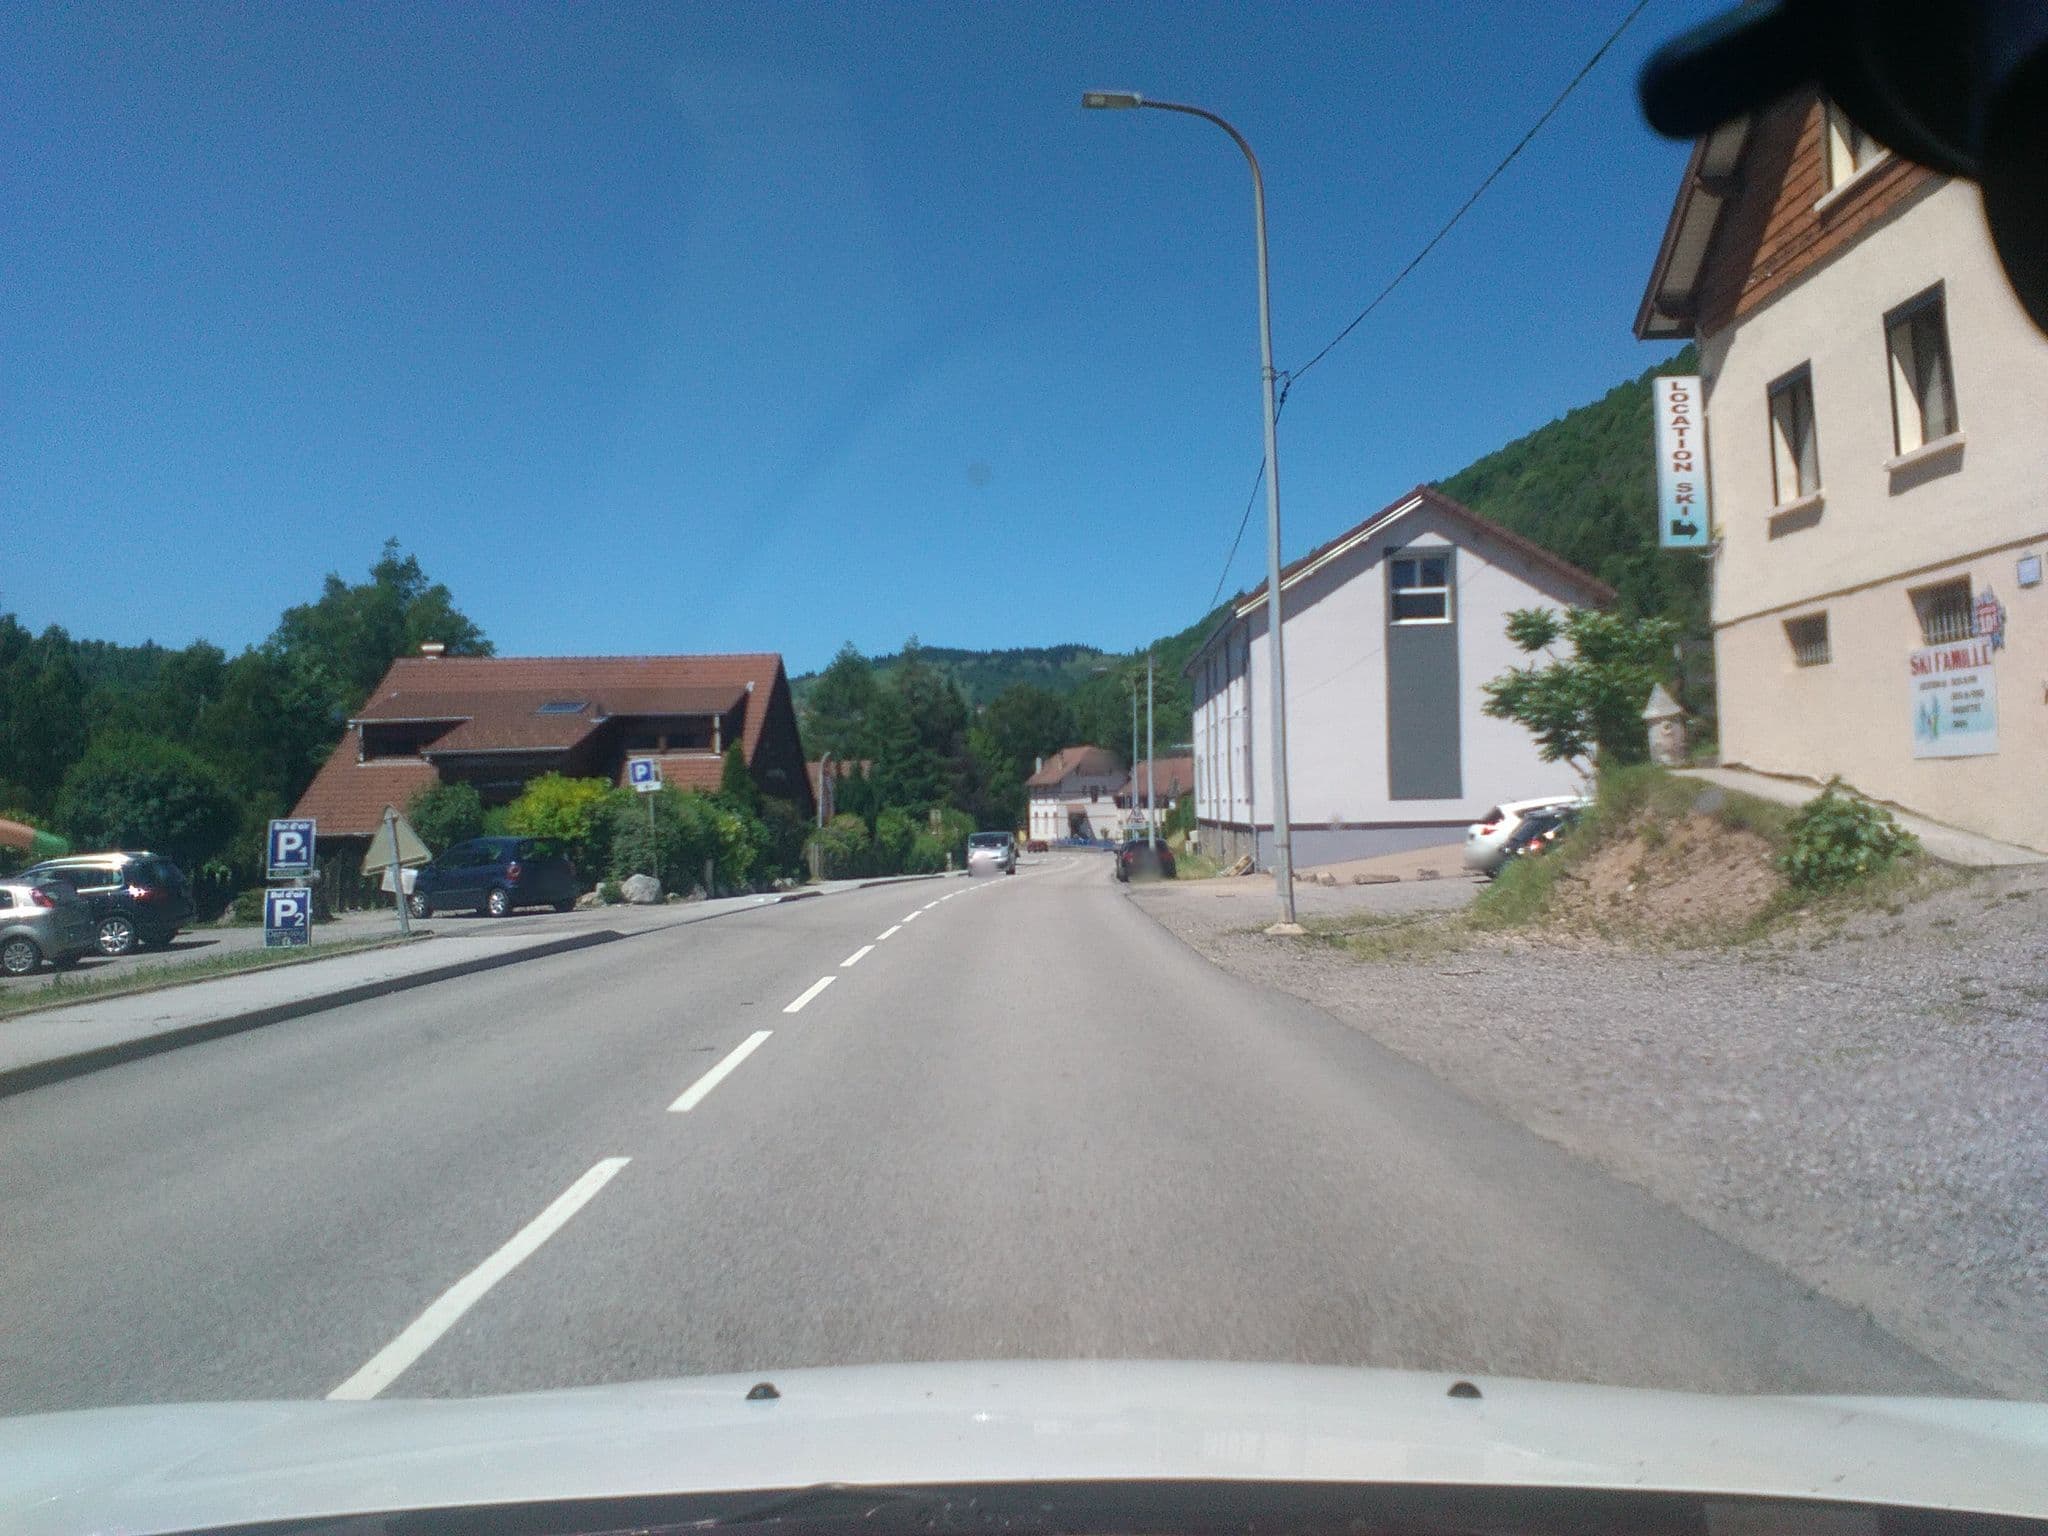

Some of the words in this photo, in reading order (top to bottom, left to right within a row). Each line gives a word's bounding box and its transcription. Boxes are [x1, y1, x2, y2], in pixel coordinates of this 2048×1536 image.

[1669, 382, 1693, 472] LOCATION
[1675, 482, 1694, 516] SKI
[634, 764, 648, 780] P
